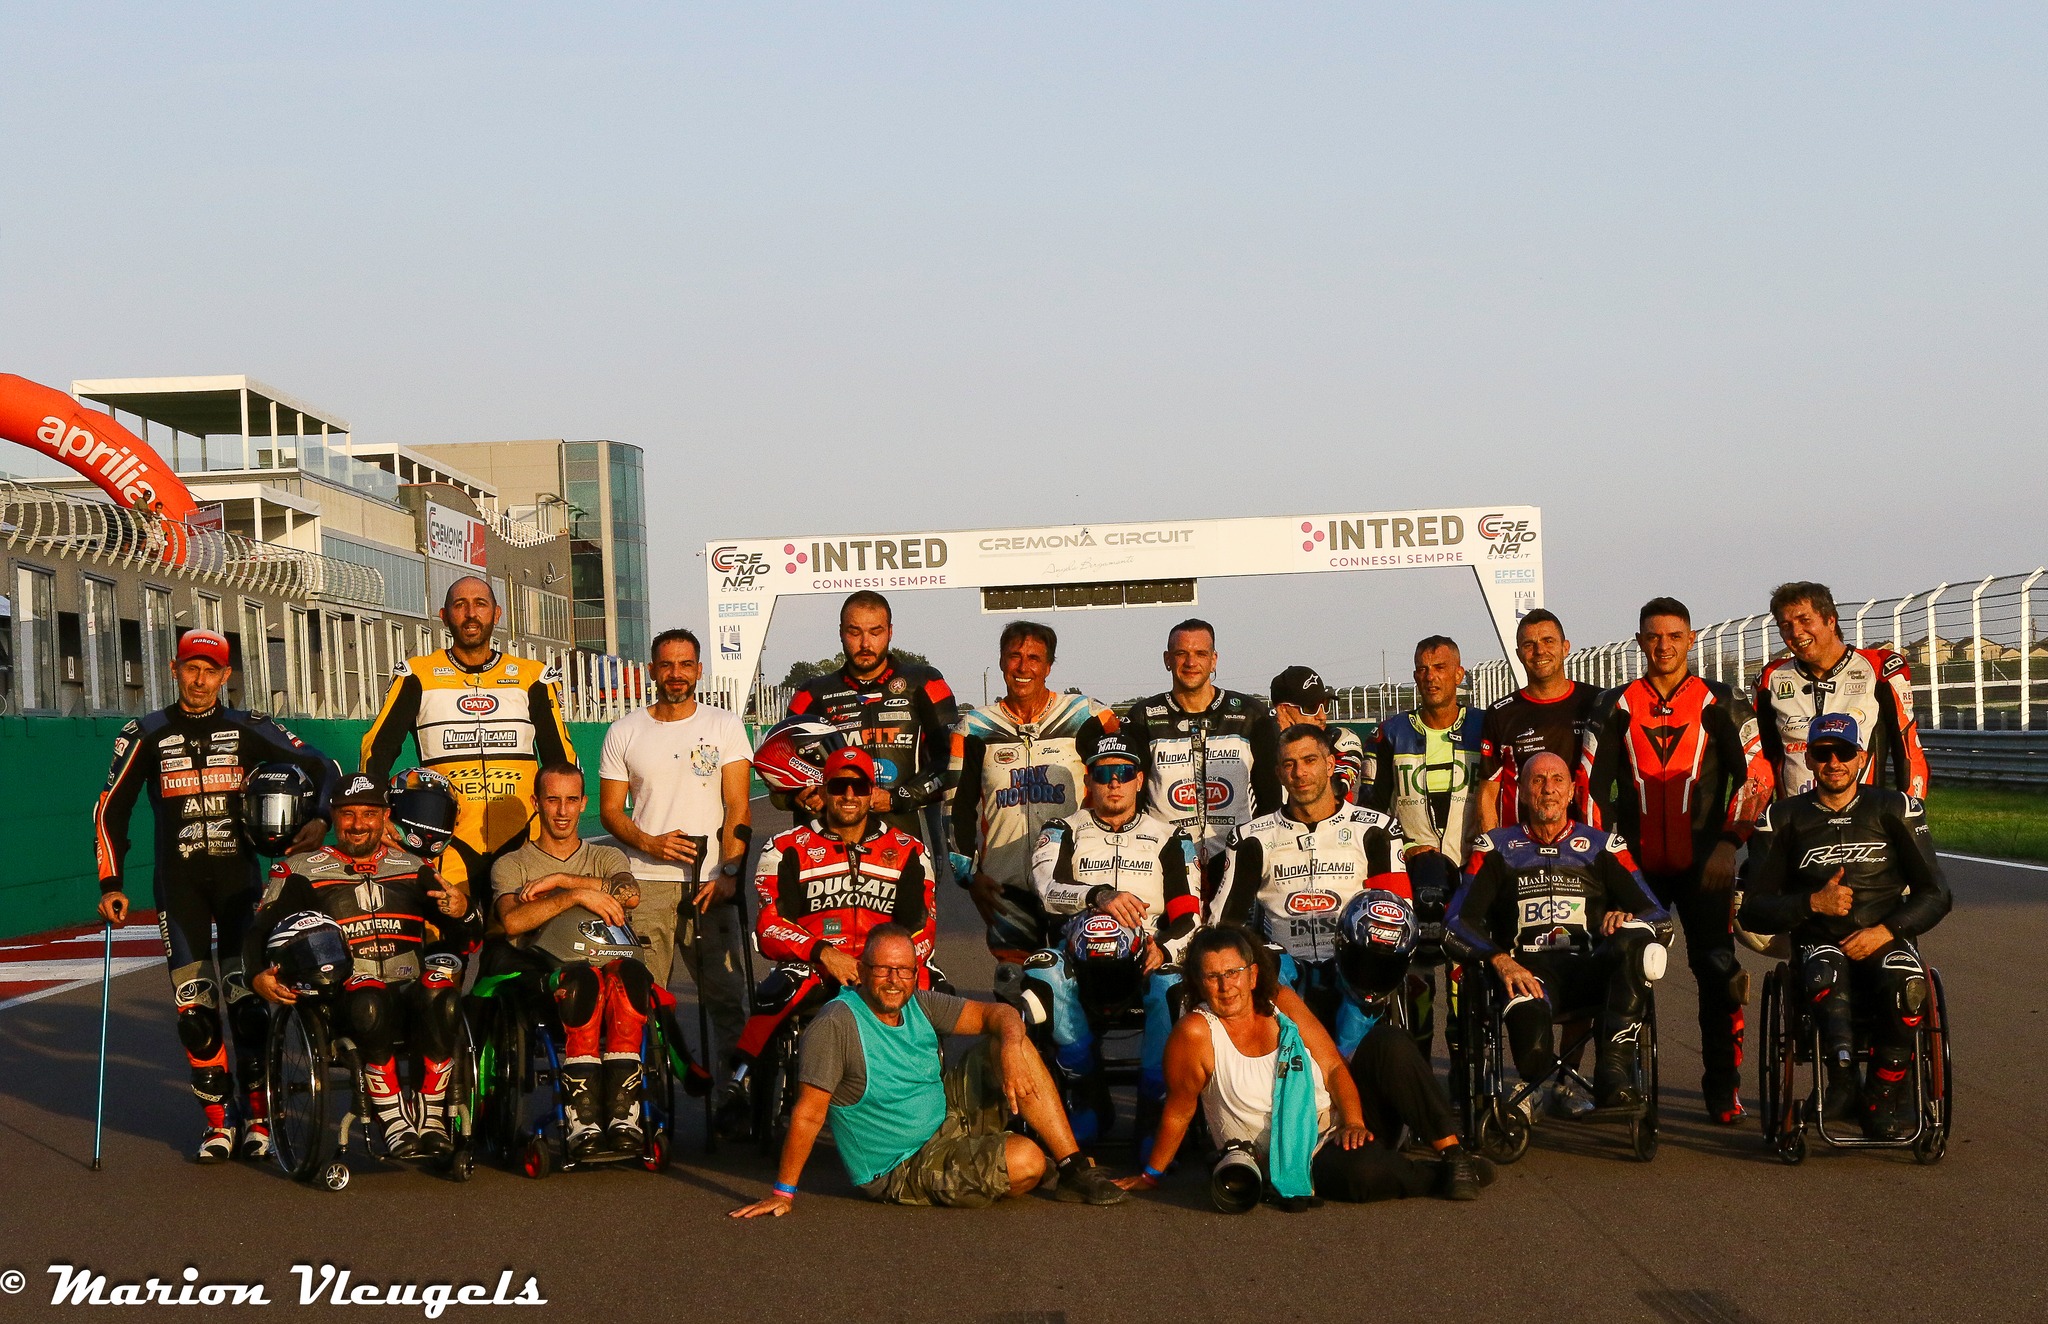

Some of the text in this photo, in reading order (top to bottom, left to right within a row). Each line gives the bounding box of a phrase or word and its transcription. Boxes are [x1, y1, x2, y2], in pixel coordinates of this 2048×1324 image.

[37, 416, 156, 505] aprilia
[978, 529, 1194, 551] CREMONA CIRCUIT
[1329, 515, 1465, 551] INTRED
[811, 538, 948, 573] INTRED
[1329, 552, 1464, 567] CONNESSI SEMPRE
[1494, 569, 1536, 579] EFFECI
[812, 574, 947, 590] CONNESSI SEMPRE
[1514, 590, 1536, 599] LEALI
[718, 602, 759, 612] EFFECI
[719, 625, 741, 633] LEALI
[720, 652, 742, 661] VETRI
[464, 700, 492, 710] PATA
[444, 730, 476, 742] NUOVA
[1157, 751, 1188, 763] NUOVA
[1010, 765, 1050, 787] MAK
[453, 782, 516, 795] NEXUM
[1178, 786, 1223, 801] PATA
[996, 784, 1066, 809] MOTORS
[1800, 842, 1887, 869] RST
[1079, 857, 1110, 870] NUOVA
[1273, 863, 1309, 878] NUOVA
[807, 873, 897, 900] DUCATI
[810, 892, 895, 915] BAYONNE
[1294, 898, 1330, 908] PATA
[1375, 906, 1400, 917] PATA
[342, 918, 402, 935] MATERIA
[1090, 921, 1113, 931] PATA
[765, 924, 810, 944] DUCATI
[598, 949, 634, 957] puntomoto
